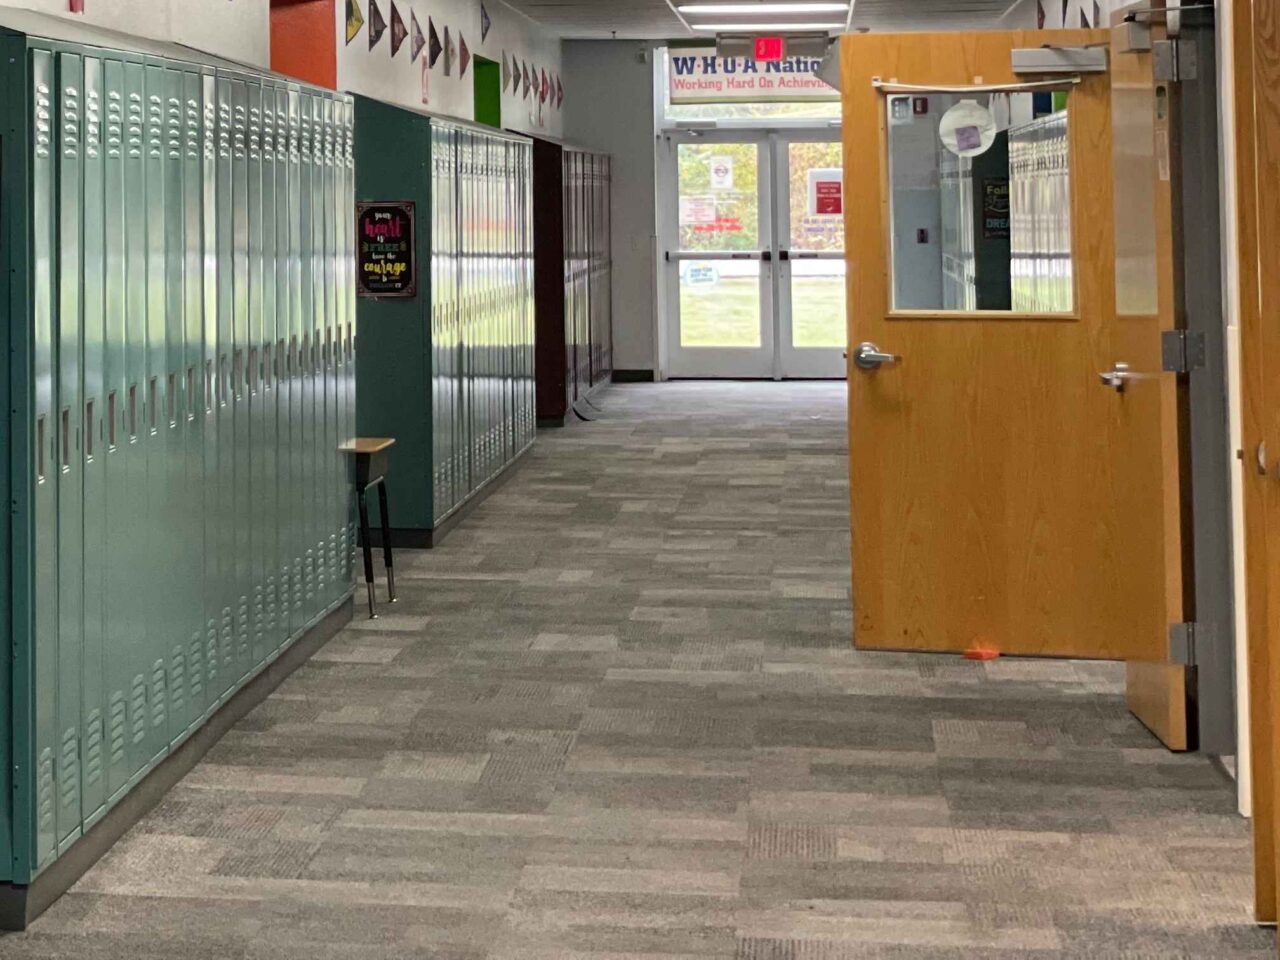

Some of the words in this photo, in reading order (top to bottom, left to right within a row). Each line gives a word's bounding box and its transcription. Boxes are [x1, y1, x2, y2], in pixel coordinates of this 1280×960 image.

[672, 77, 723, 92] Working
[727, 77, 755, 89] Hard
[758, 76, 774, 88] On
